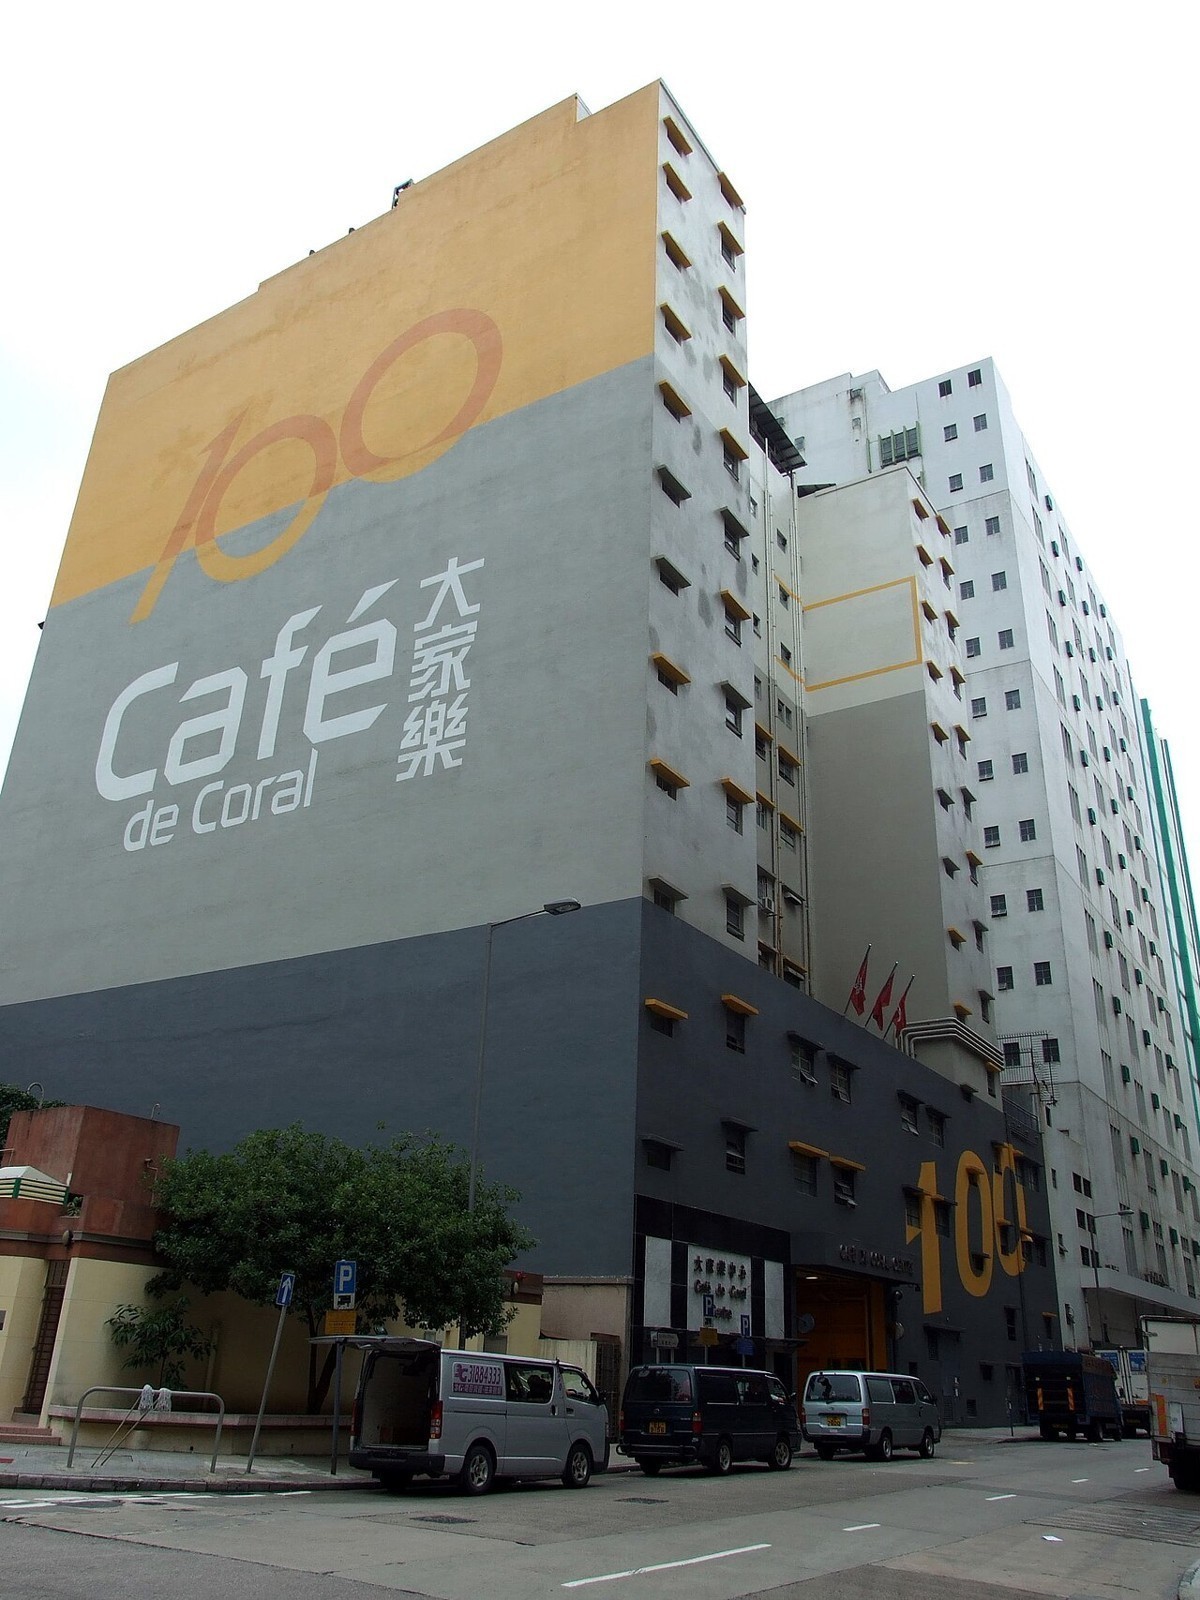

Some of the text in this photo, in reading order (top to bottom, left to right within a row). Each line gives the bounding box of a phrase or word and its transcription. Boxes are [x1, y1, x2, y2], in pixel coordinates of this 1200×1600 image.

[128, 308, 502, 627] 100
[95, 577, 399, 801] Café
[396, 555, 484, 782] 大家樂
[123, 747, 319, 852] de Coral
[339, 1264, 352, 1292] P
[906, 1142, 1029, 1315] 100
[705, 1296, 713, 1316] P
[742, 1317, 749, 1335] P
[468, 1364, 501, 1385] 31884333
